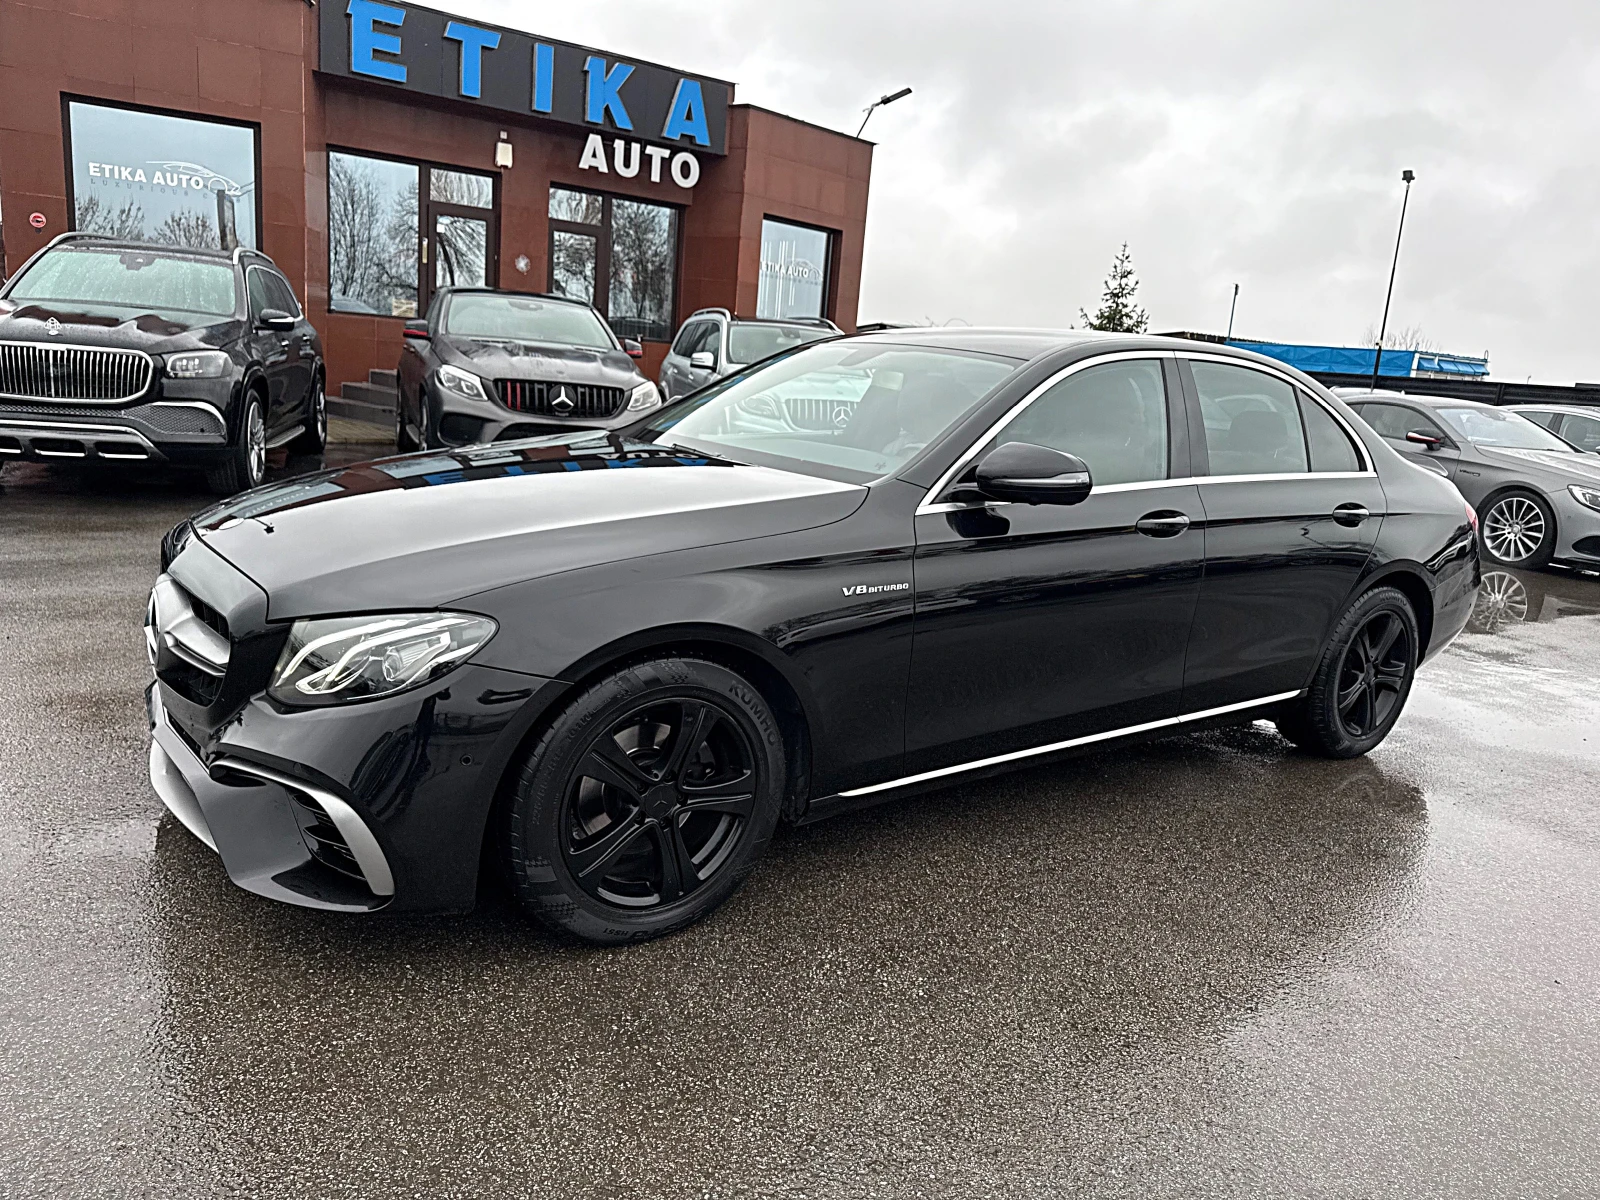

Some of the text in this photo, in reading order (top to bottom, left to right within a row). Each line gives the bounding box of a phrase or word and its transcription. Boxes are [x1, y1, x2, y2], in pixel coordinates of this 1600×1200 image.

[346, 0, 711, 146] ETIKA
[578, 133, 700, 189] AUTO
[88, 162, 204, 190] ETIKA AUTO
[90, 178, 189, 197] LUXURIOUS
[786, 265, 809, 278] AUTO
[842, 582, 909, 597] V8 BITURBO
[728, 681, 778, 747] KUMHO
